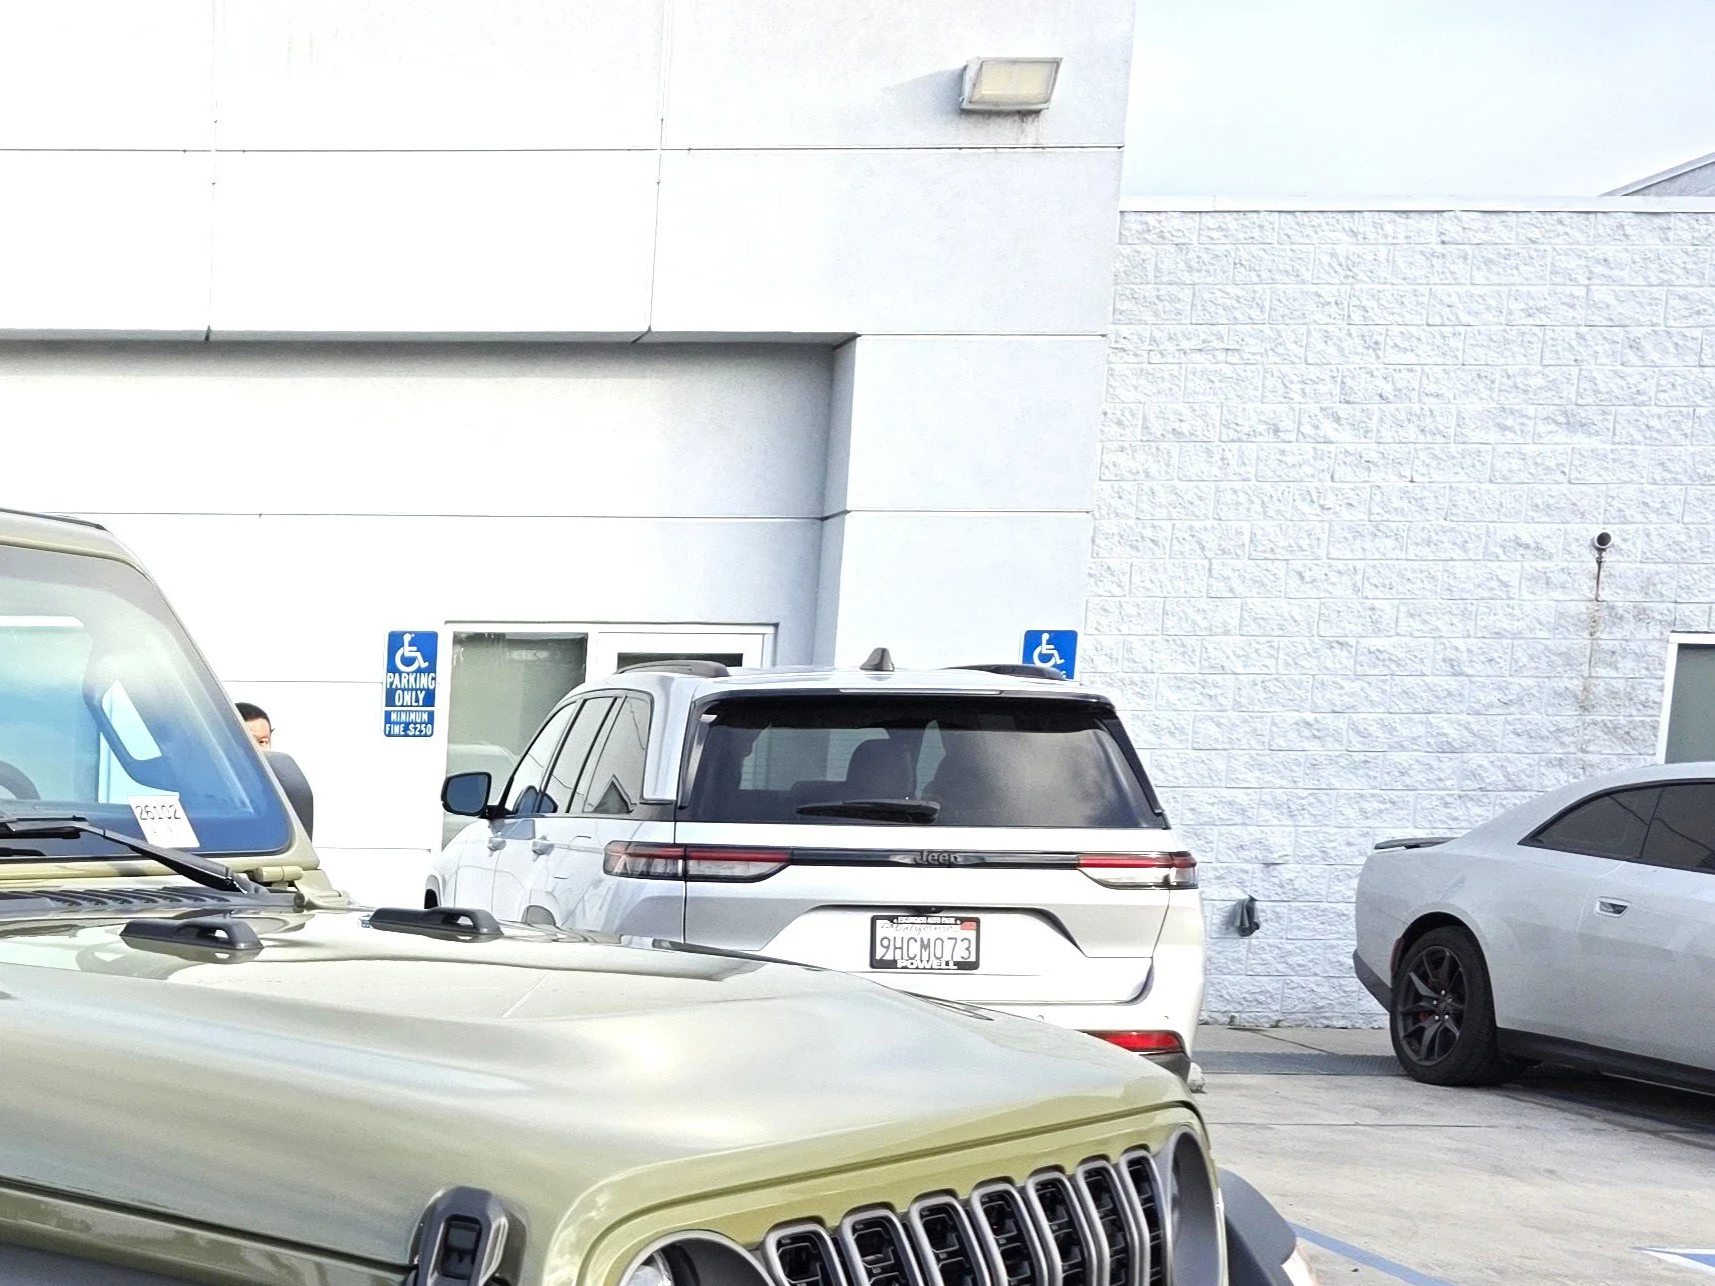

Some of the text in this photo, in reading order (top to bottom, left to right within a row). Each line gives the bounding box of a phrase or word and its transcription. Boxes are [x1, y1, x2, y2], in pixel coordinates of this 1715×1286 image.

[387, 672, 436, 689] PARKING
[394, 690, 426, 706] ONLY
[390, 711, 428, 723] MINIMUM
[386, 724, 405, 735] FINE
[914, 849, 960, 868] Jeep
[880, 936, 972, 961] 9HCM073
[896, 959, 958, 969] POWELL
